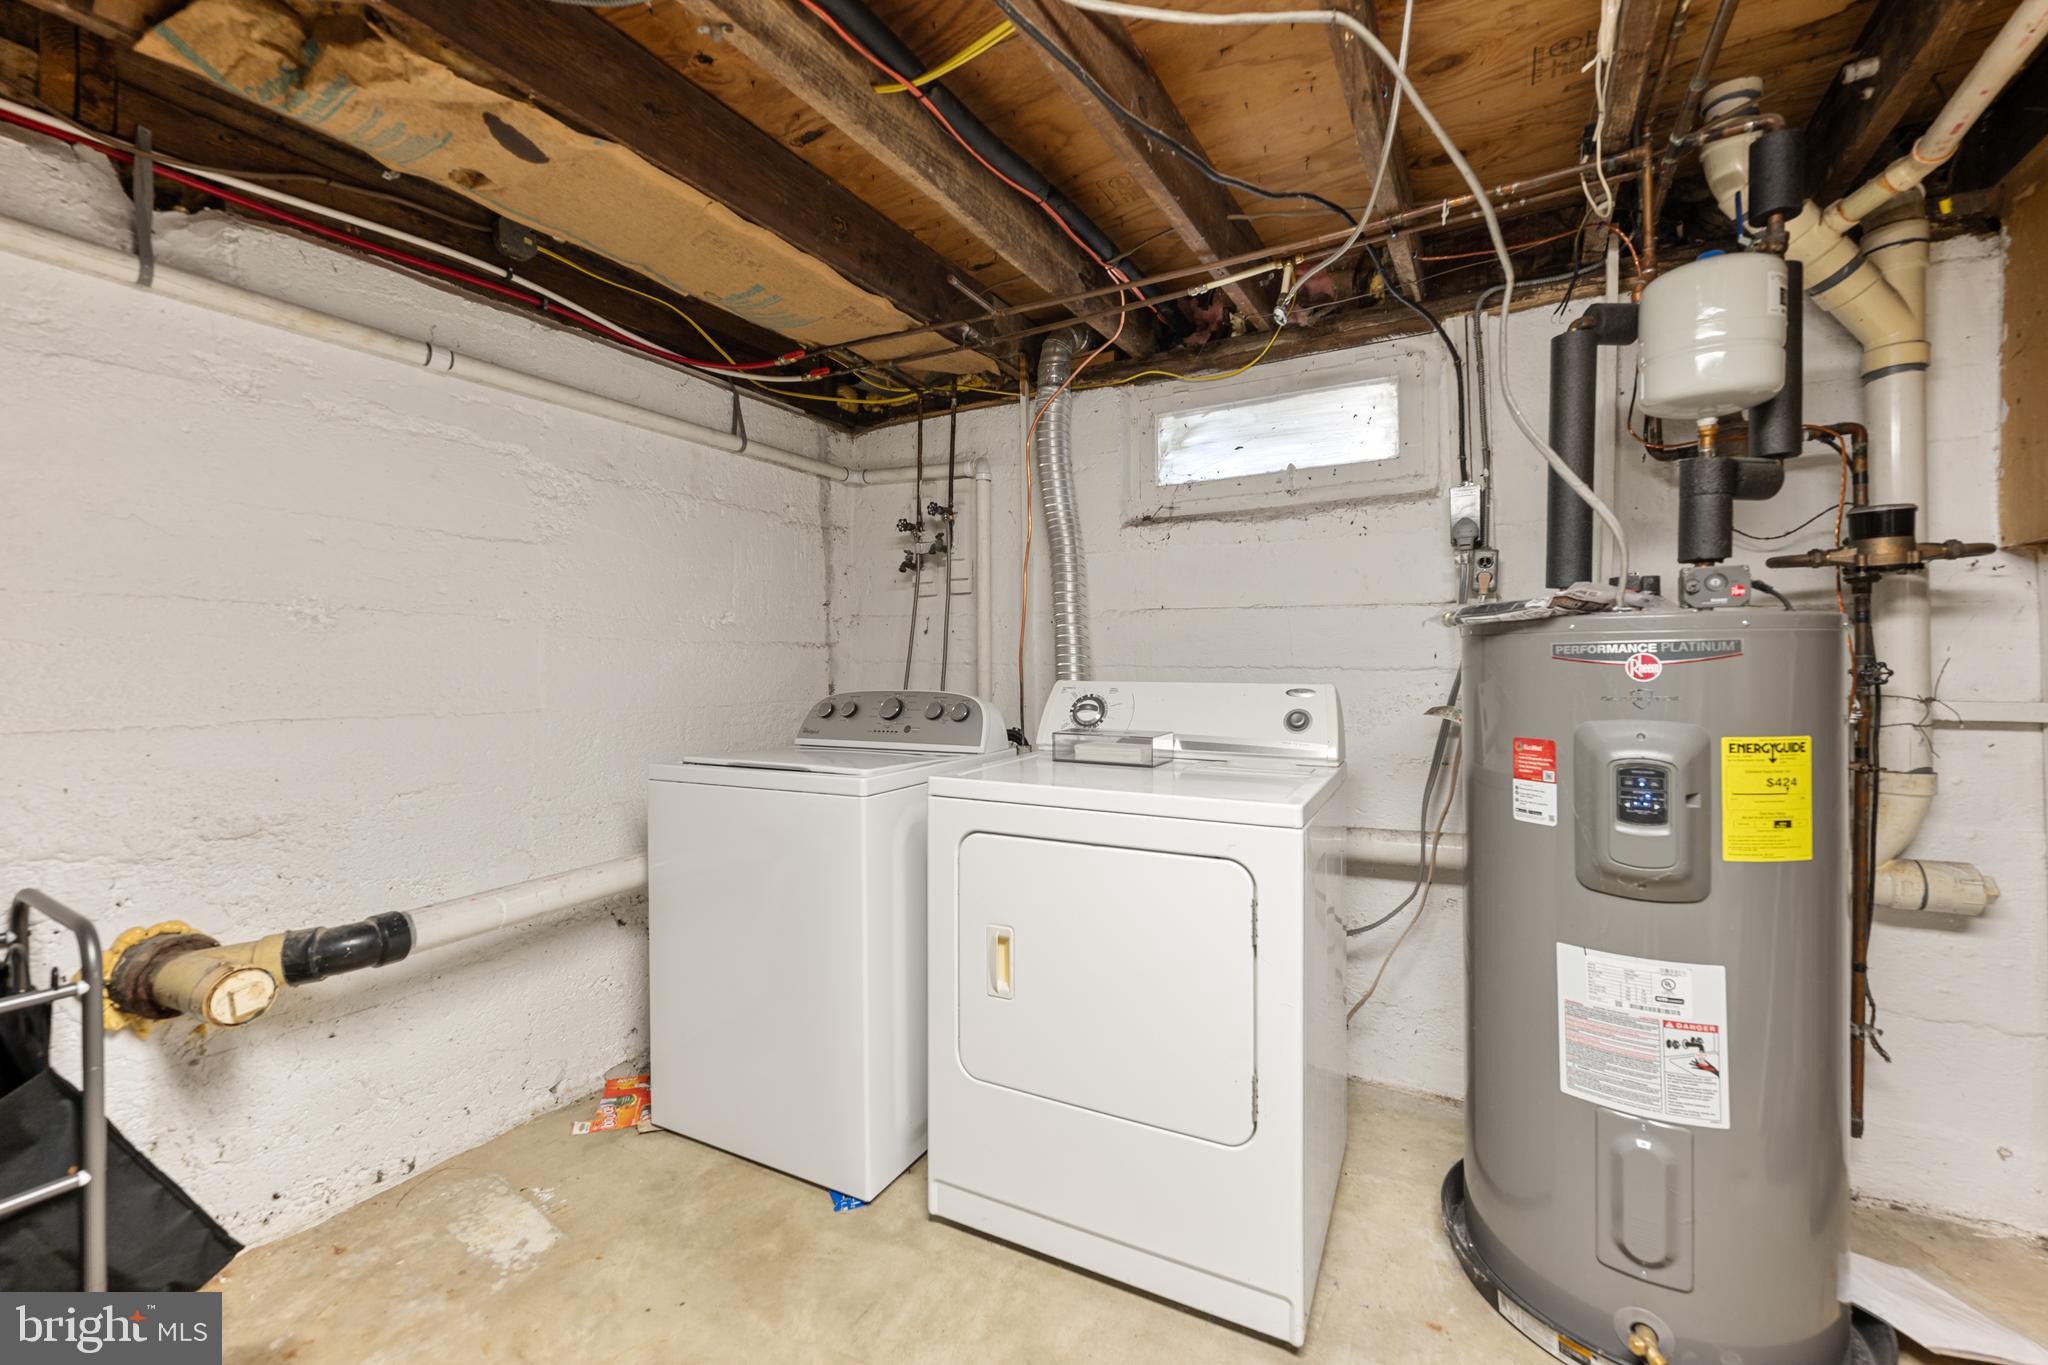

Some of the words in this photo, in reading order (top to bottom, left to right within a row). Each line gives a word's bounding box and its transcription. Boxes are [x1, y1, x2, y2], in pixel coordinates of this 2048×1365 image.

[1556, 643, 1657, 654] PERFORMANCE
[1661, 641, 1735, 652] PLATINUM
[1675, 1022, 1716, 1032] DANGER
